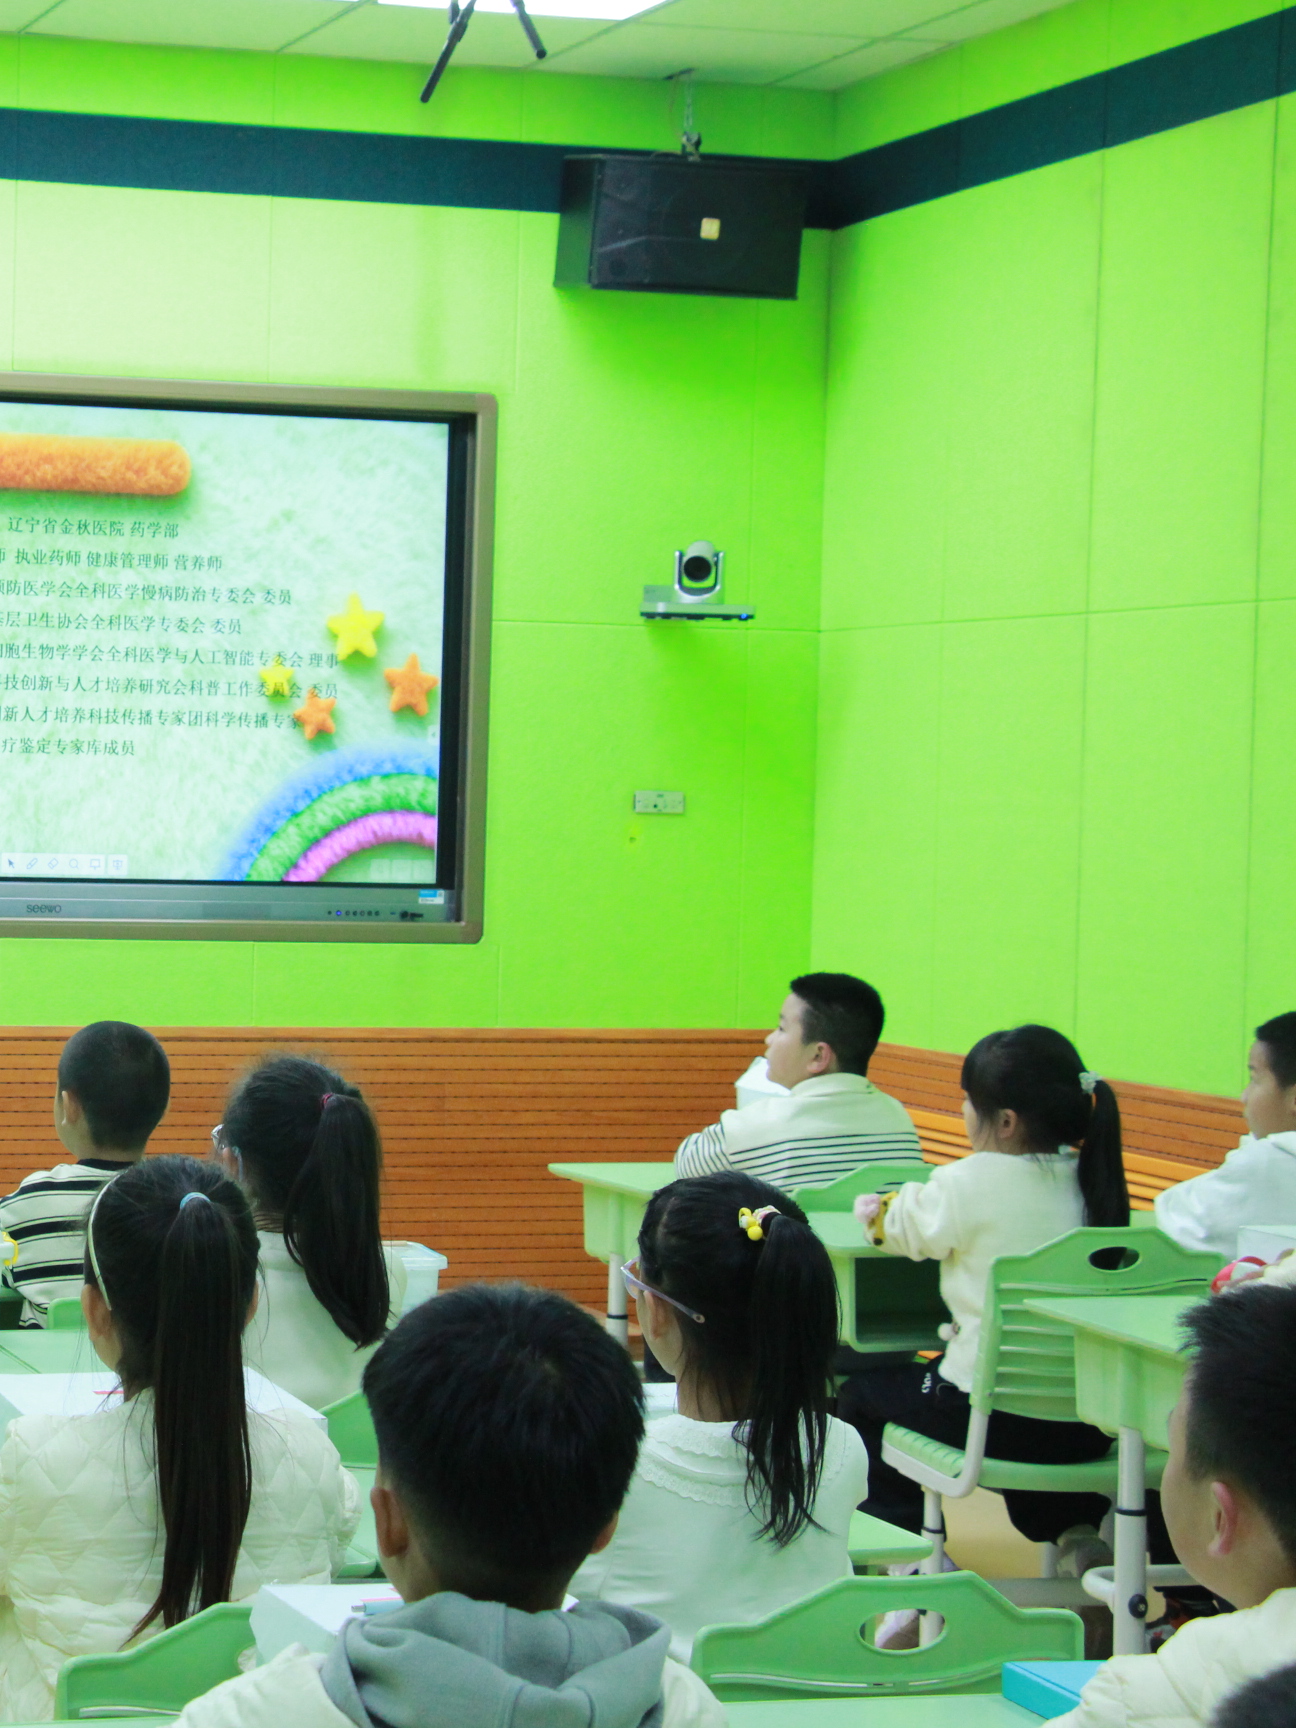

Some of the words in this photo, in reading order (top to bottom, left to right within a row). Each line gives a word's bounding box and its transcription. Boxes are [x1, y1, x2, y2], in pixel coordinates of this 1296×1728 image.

[130, 521, 179, 539] 药学部
[15, 548, 81, 567] 执业药师
[87, 551, 169, 570] 健康管理师
[174, 554, 223, 571] 营养师
[261, 589, 292, 605] 委员
[211, 618, 242, 635] 委员
[309, 652, 339, 668] 理事
[309, 683, 338, 699] 委员
[26, 904, 62, 913] seewo
